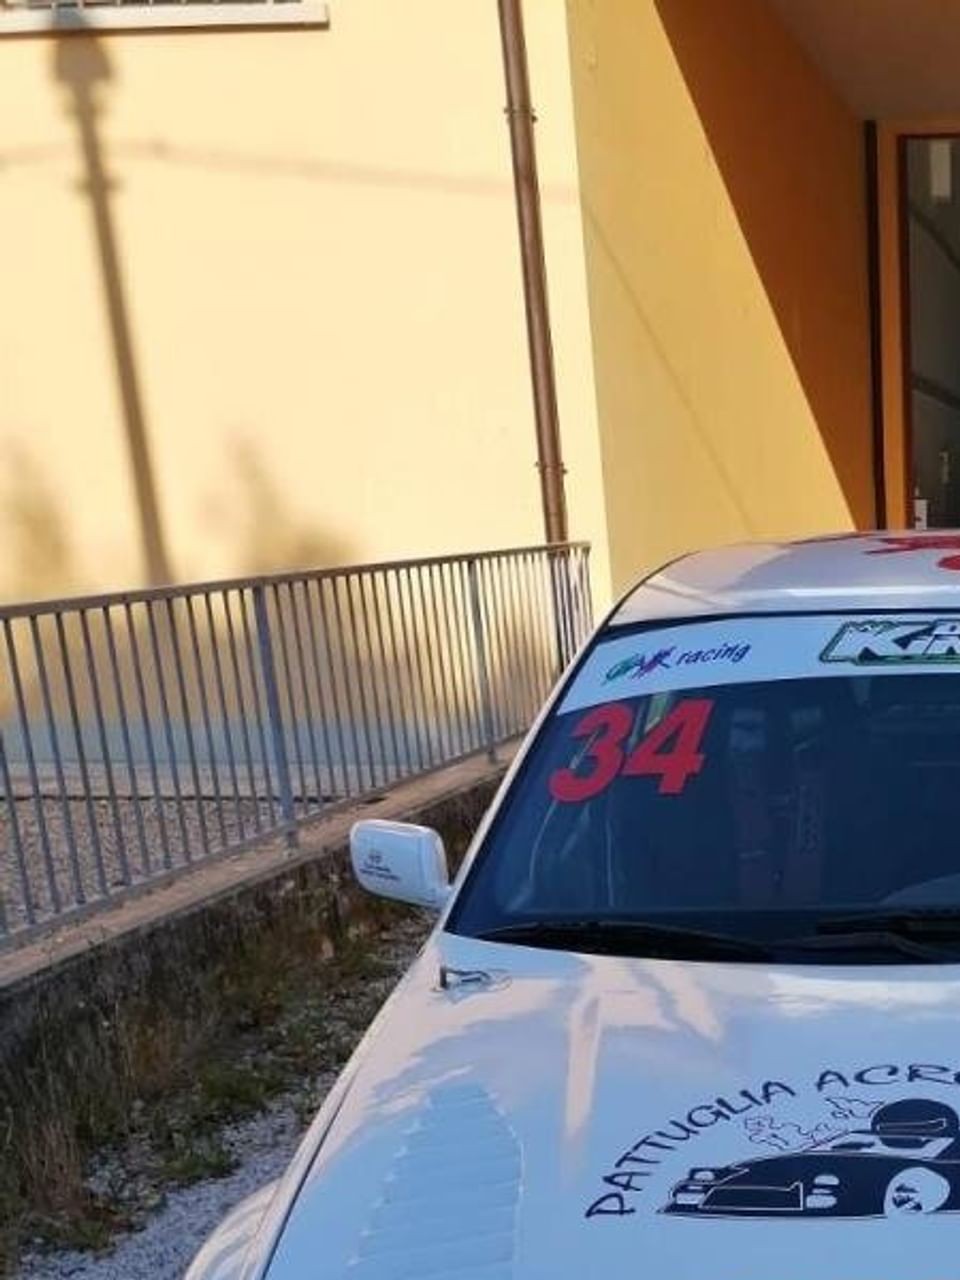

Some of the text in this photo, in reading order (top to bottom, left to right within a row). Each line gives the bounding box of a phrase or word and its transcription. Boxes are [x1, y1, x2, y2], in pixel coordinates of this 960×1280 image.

[677, 643, 751, 666] racing
[549, 698, 714, 803] 34
[585, 1080, 796, 1218] PATTUGLIA
